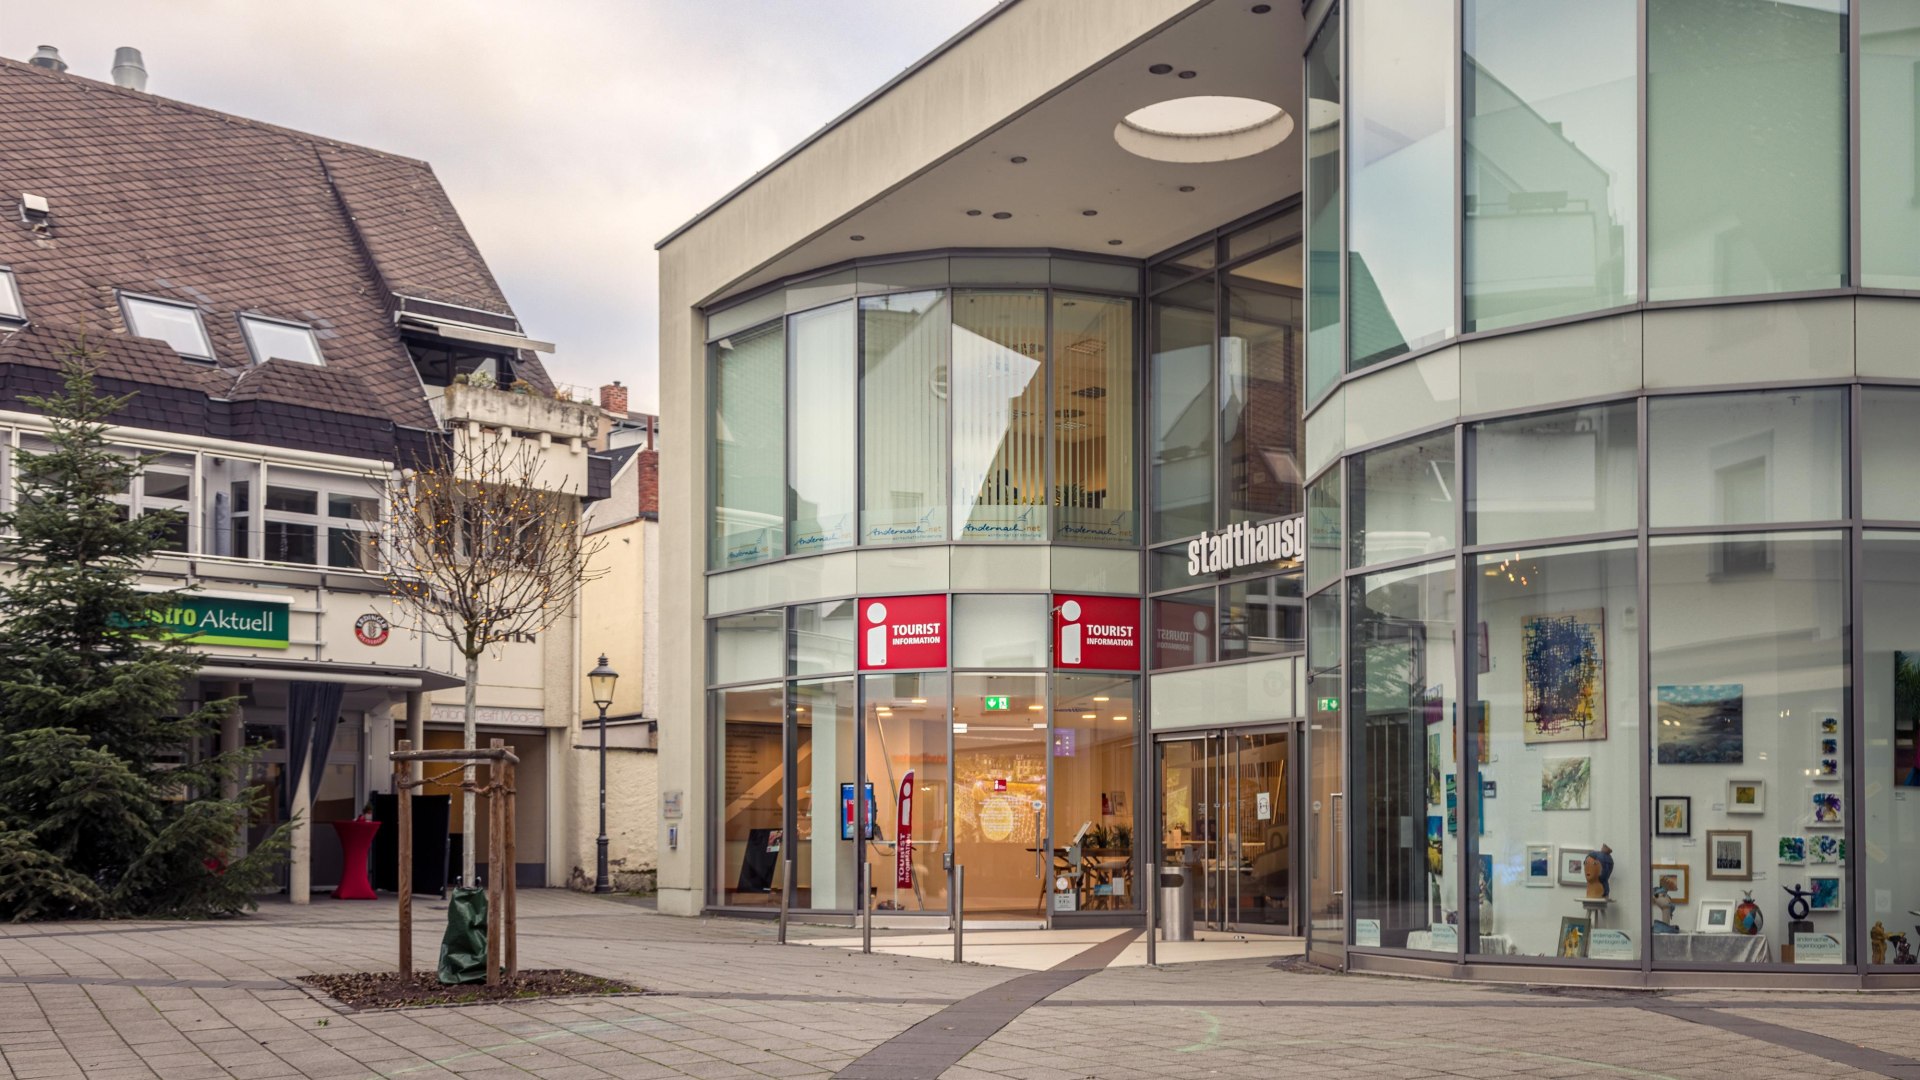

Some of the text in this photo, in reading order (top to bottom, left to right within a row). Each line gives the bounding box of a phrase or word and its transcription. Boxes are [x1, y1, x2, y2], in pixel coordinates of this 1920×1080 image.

[1187, 516, 1304, 576] stadthausg
[199, 609, 273, 632] Aktuell
[892, 622, 941, 636] TOURIST
[1086, 624, 1134, 637] TOURIST
[892, 636, 941, 646] INFORMATION
[1086, 637, 1134, 647] INFORMATION
[898, 833, 906, 882] TOURIST
